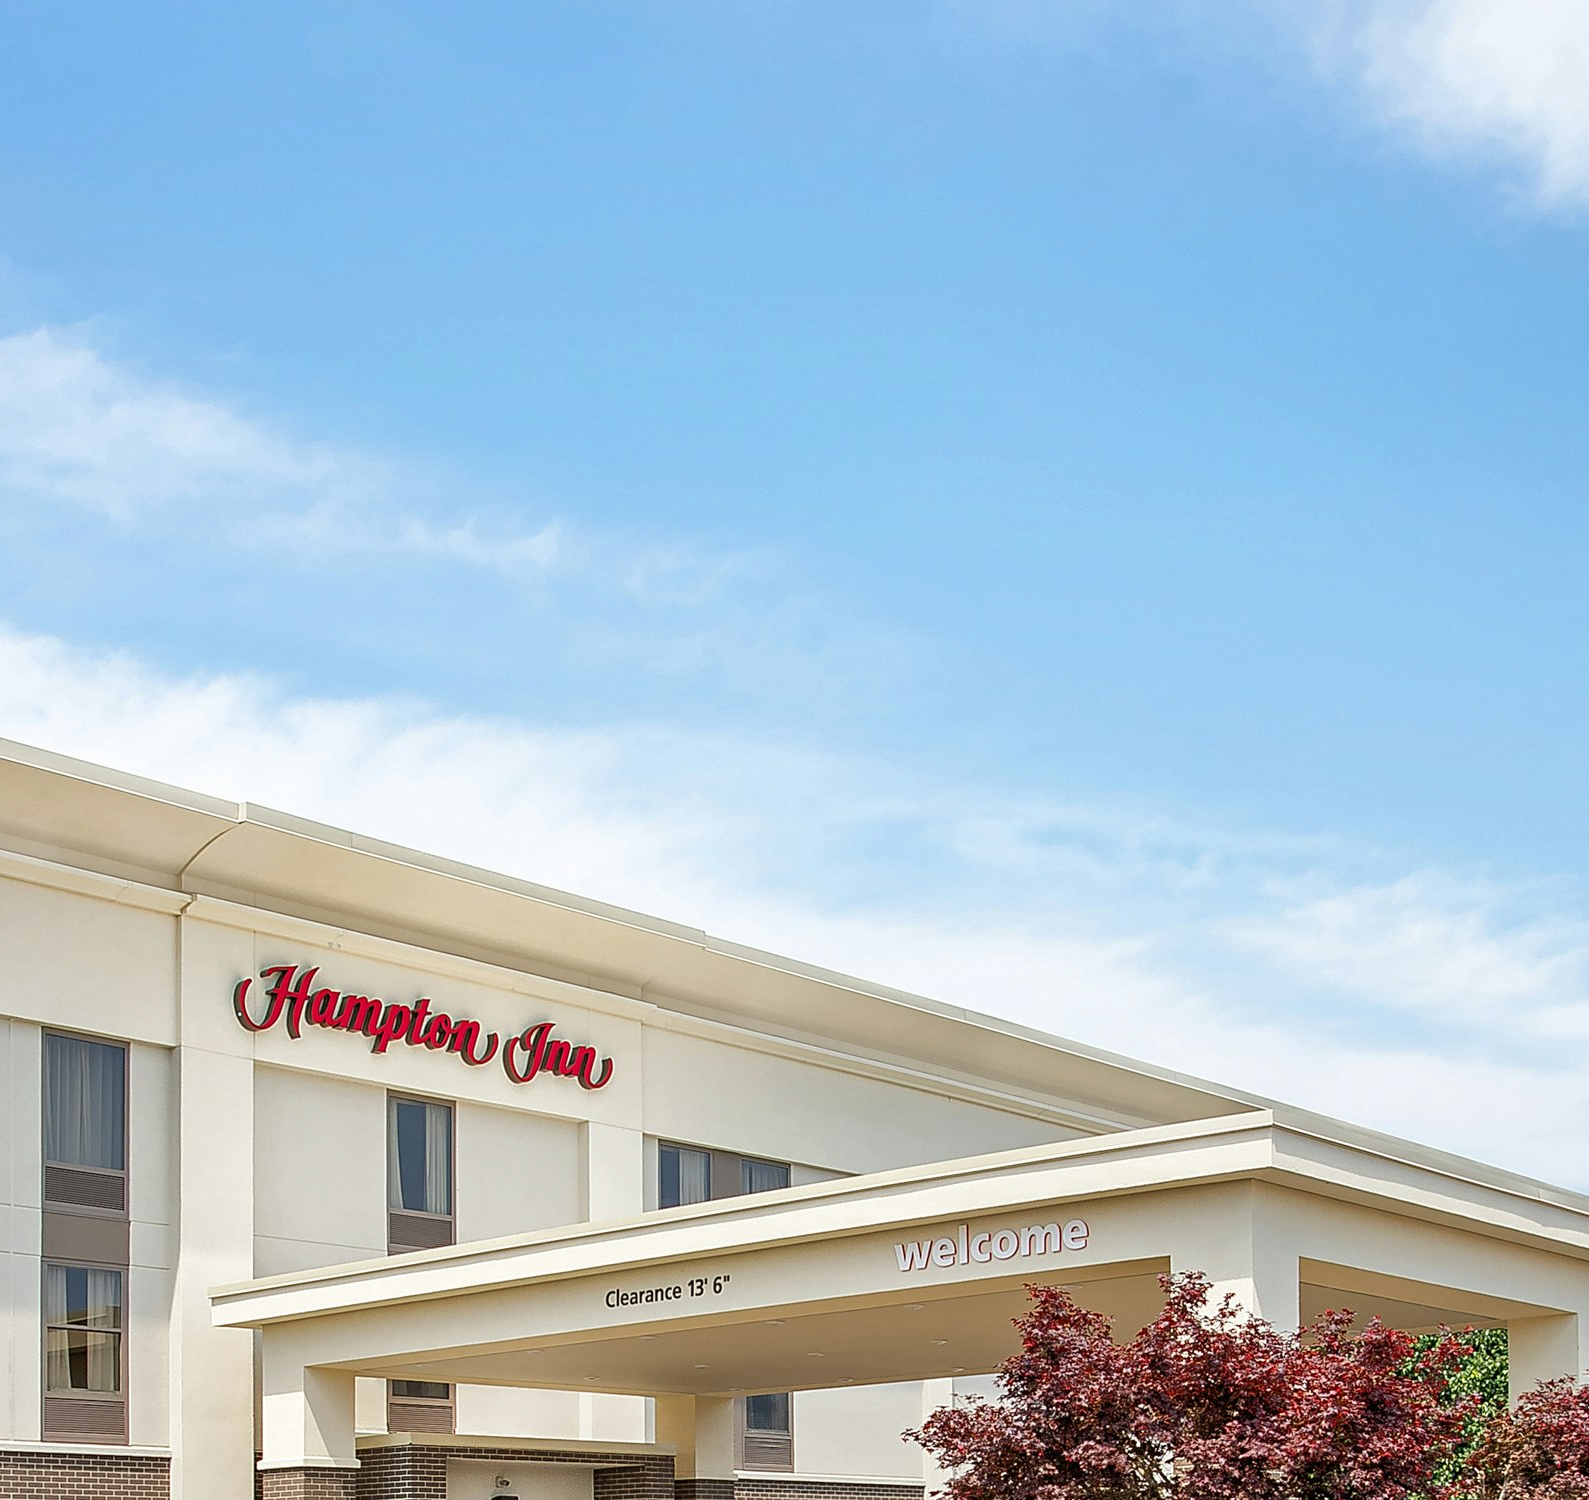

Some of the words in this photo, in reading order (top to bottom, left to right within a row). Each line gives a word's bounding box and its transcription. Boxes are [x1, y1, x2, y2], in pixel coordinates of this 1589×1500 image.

[234, 964, 499, 1067] Hampton
[503, 1022, 614, 1090] Inn
[894, 1219, 1089, 1272] welcome
[605, 1285, 682, 1308] Clearance
[687, 1277, 708, 1297] 13'
[713, 1274, 731, 1294] 6"
